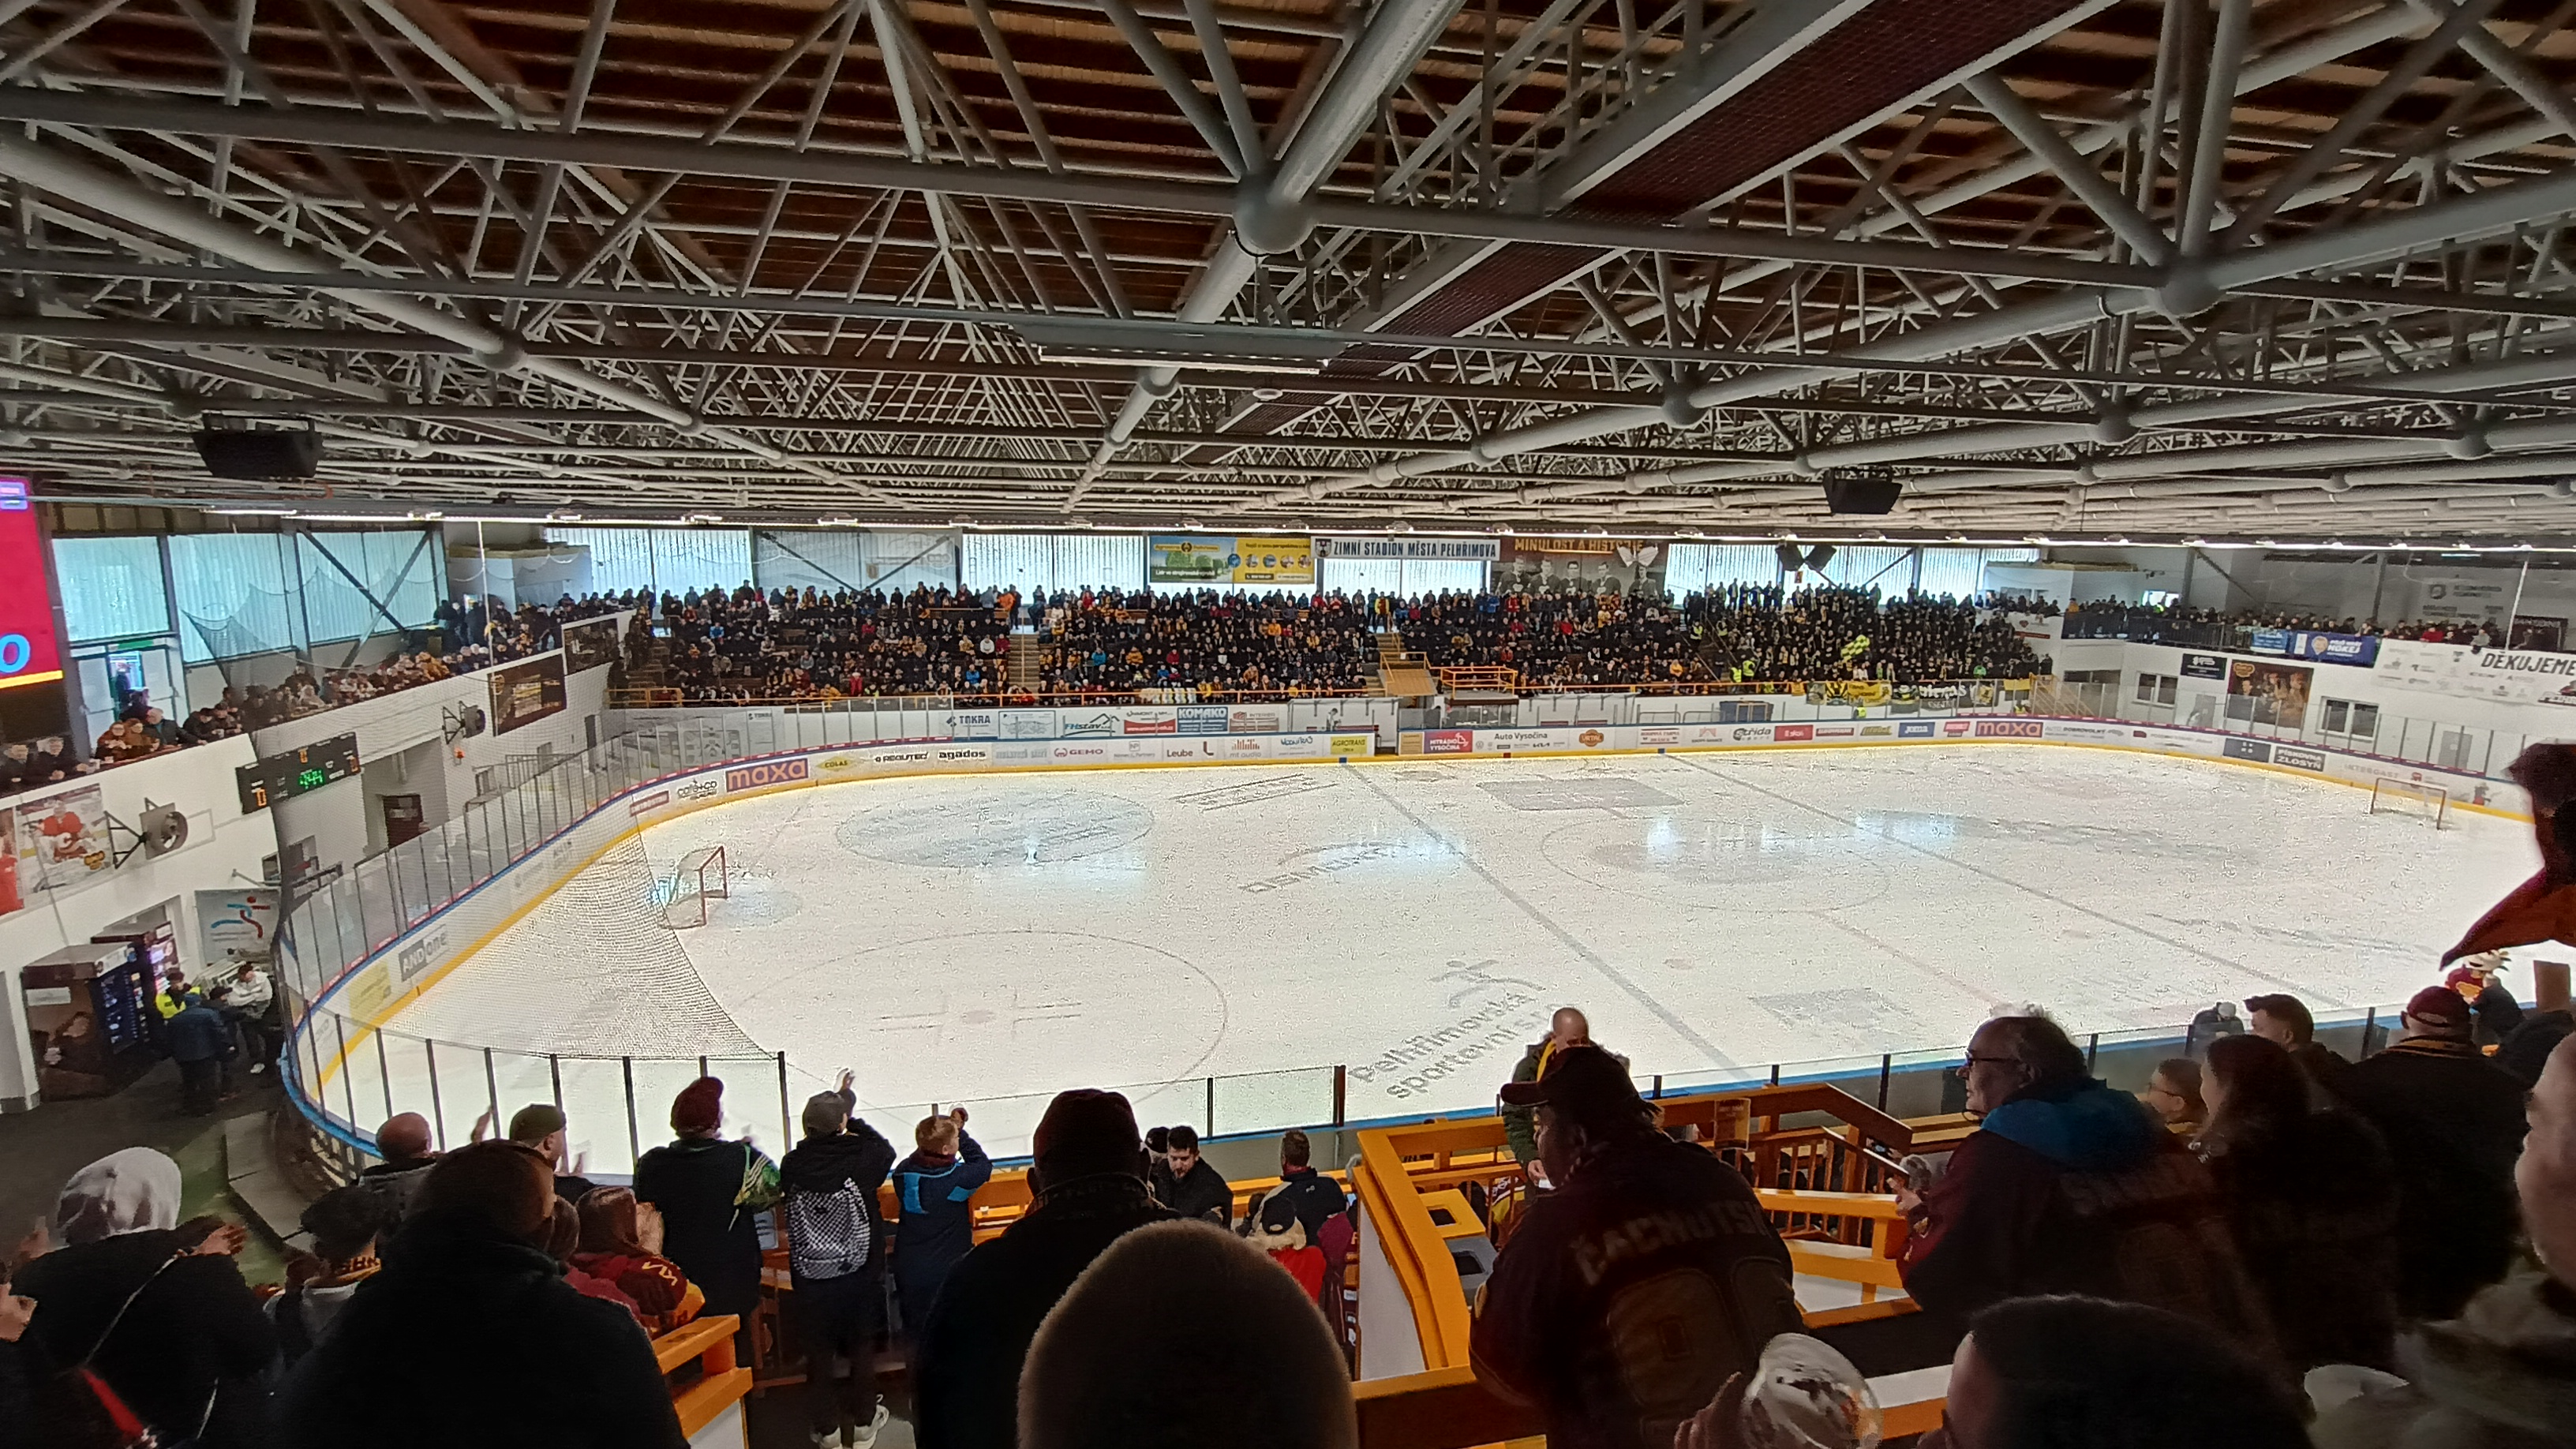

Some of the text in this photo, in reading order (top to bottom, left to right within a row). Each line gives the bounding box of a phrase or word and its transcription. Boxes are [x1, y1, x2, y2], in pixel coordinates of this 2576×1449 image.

[1334, 540, 1496, 557] ZIMNÍ STADION MĚSTA PELHŘIMOVA
[1515, 539, 1575, 551] MINULOST
[1578, 539, 1586, 551] A
[1178, 708, 1228, 719] KOMAKO
[959, 715, 991, 724] TOKRA
[1976, 721, 2042, 736] maxa
[1514, 732, 1548, 741] Vysočina
[939, 749, 987, 760] agados
[1166, 749, 1193, 758] Leube
[728, 759, 807, 791] maxa
